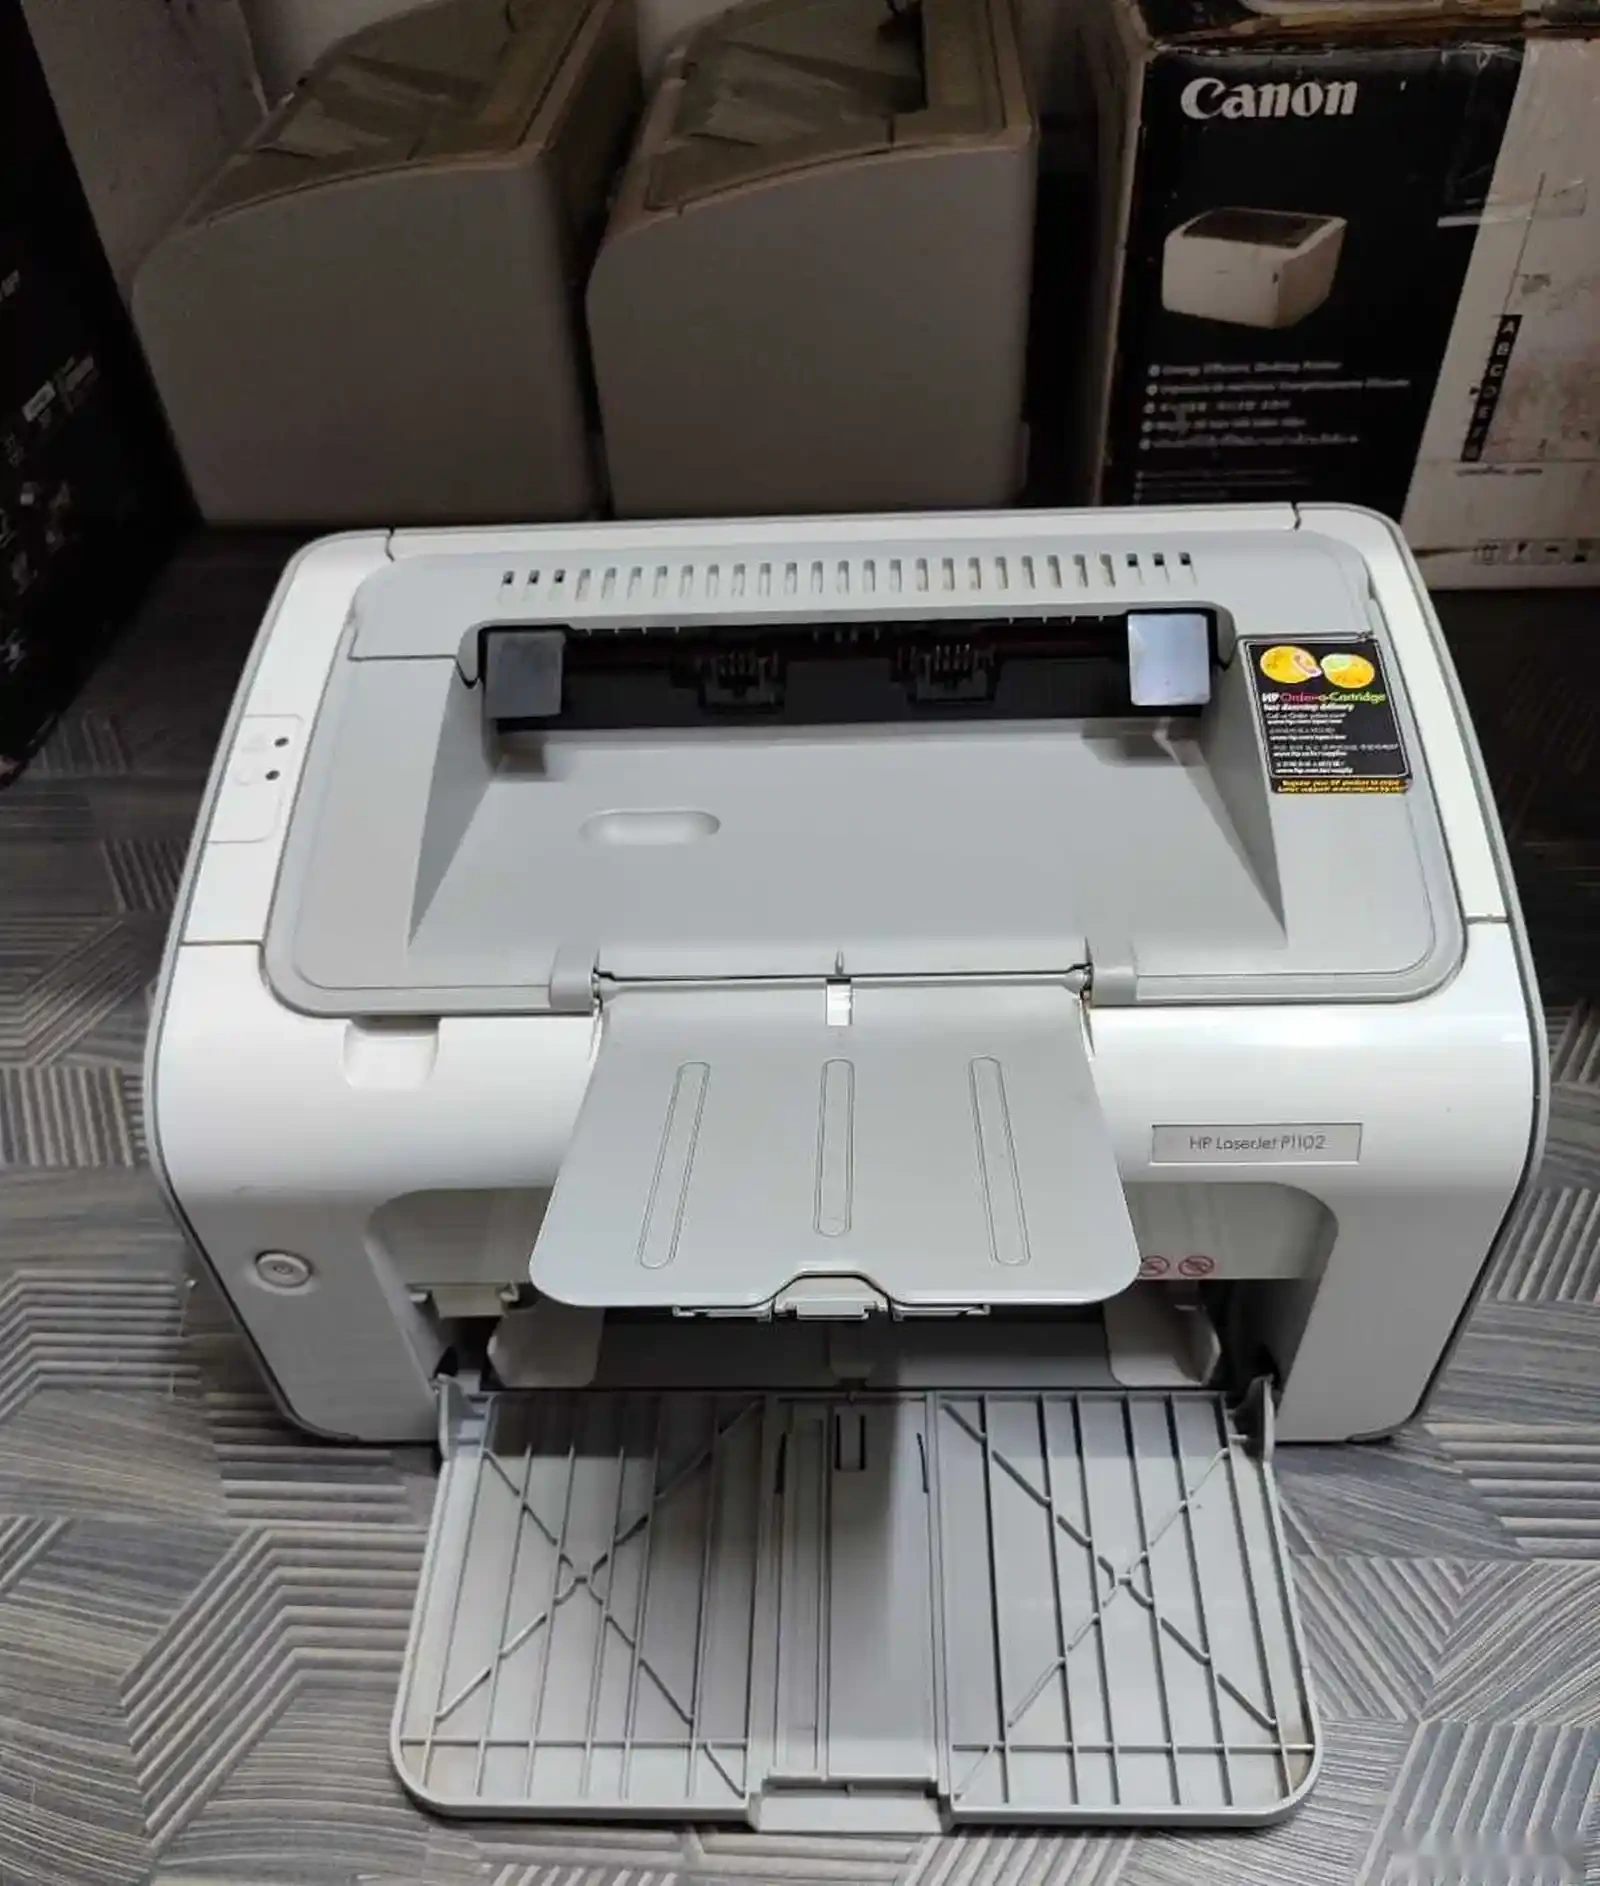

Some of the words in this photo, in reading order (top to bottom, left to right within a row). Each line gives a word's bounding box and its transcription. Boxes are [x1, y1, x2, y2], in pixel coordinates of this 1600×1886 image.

[1180, 77, 1358, 119] Canon
[1262, 692, 1280, 703] HP
[1189, 1135, 1213, 1150] HP
[1216, 1135, 1278, 1151] LaserJet
[1280, 1134, 1327, 1151] P1102
